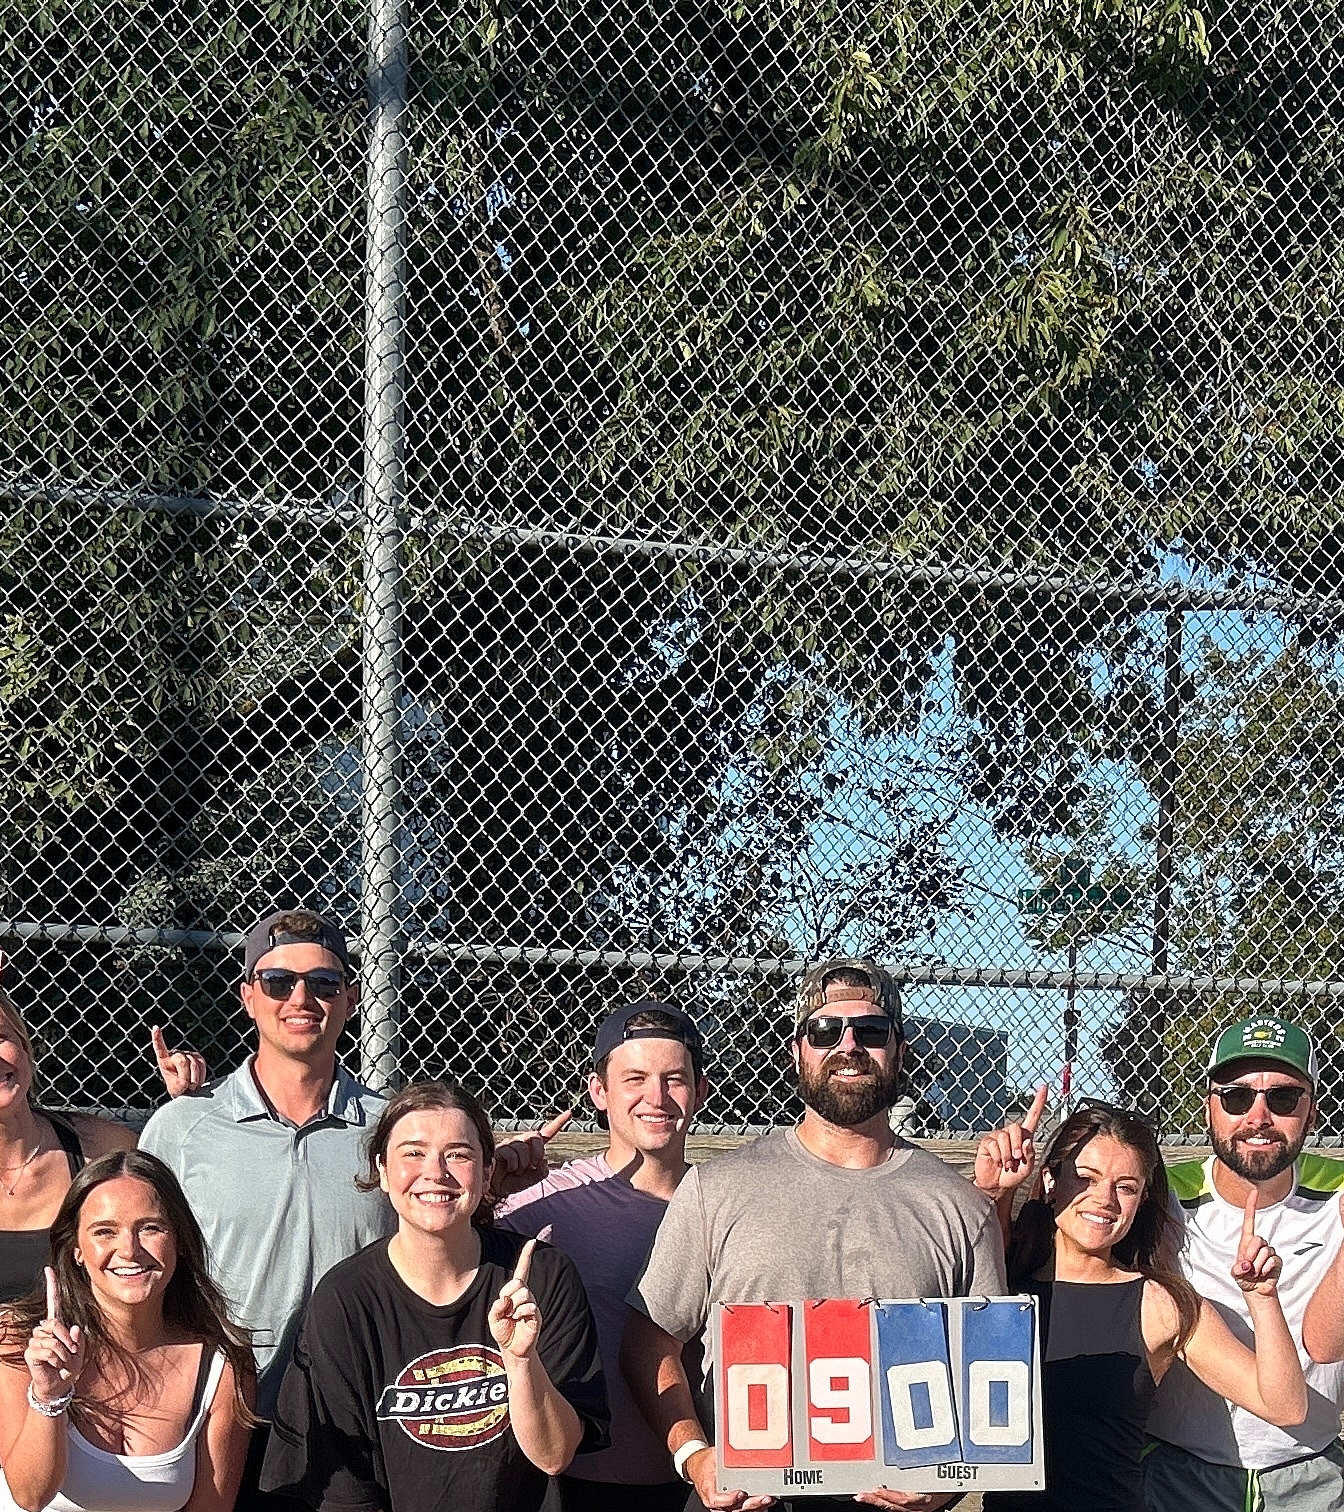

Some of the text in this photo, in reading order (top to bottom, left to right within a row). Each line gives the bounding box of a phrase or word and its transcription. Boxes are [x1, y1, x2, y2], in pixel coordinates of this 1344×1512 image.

[389, 1381, 507, 1413] Dickie
[783, 1464, 980, 1486] HOME GUEST
